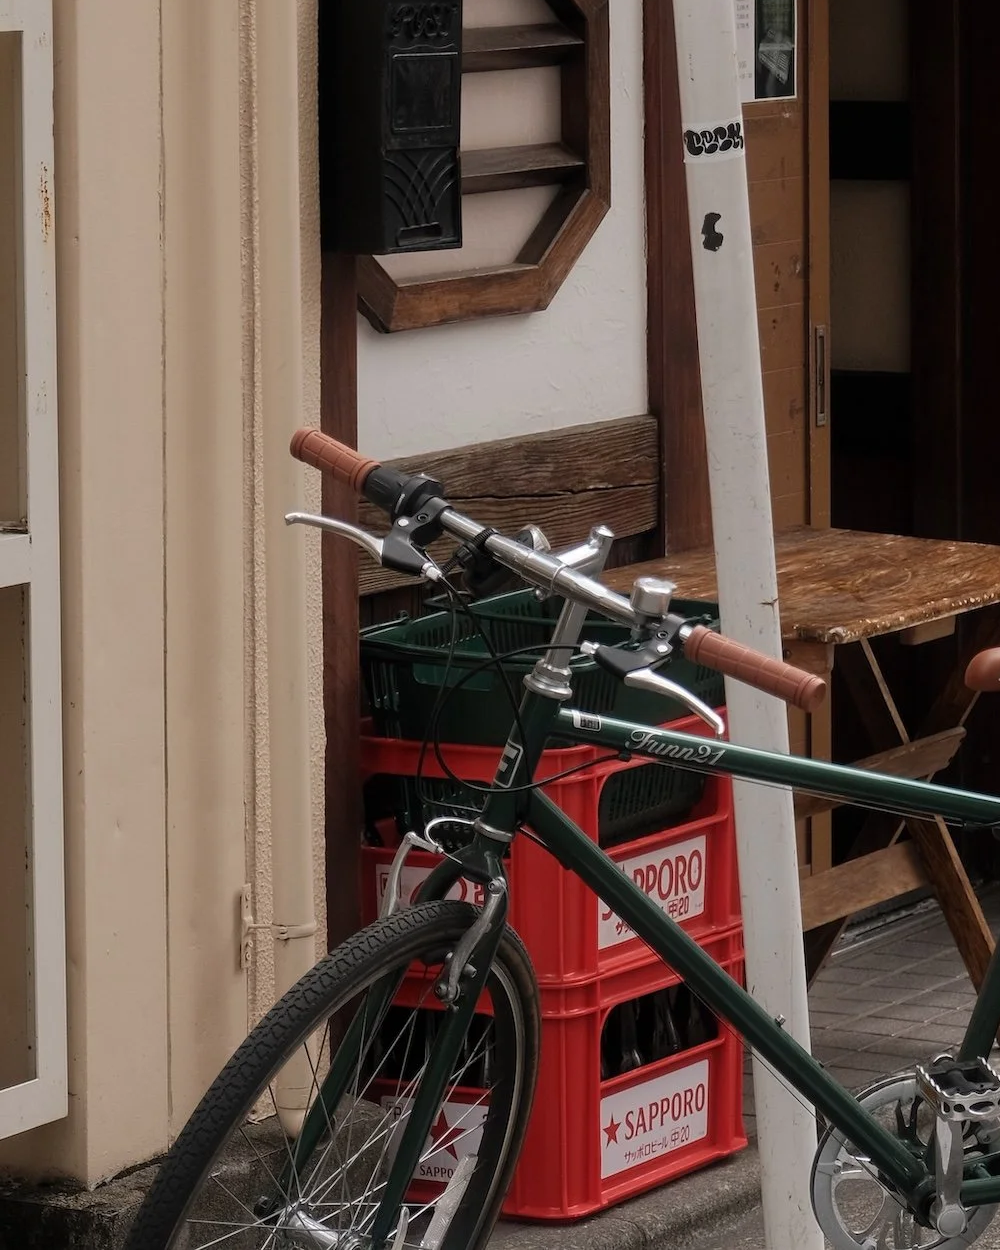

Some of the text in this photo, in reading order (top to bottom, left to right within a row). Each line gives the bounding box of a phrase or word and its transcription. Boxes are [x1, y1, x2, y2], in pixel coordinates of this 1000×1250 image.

[624, 728, 727, 767] Funn21
[624, 1083, 705, 1140] SAPPORO
[624, 1136, 669, 1164] サッポロビール
